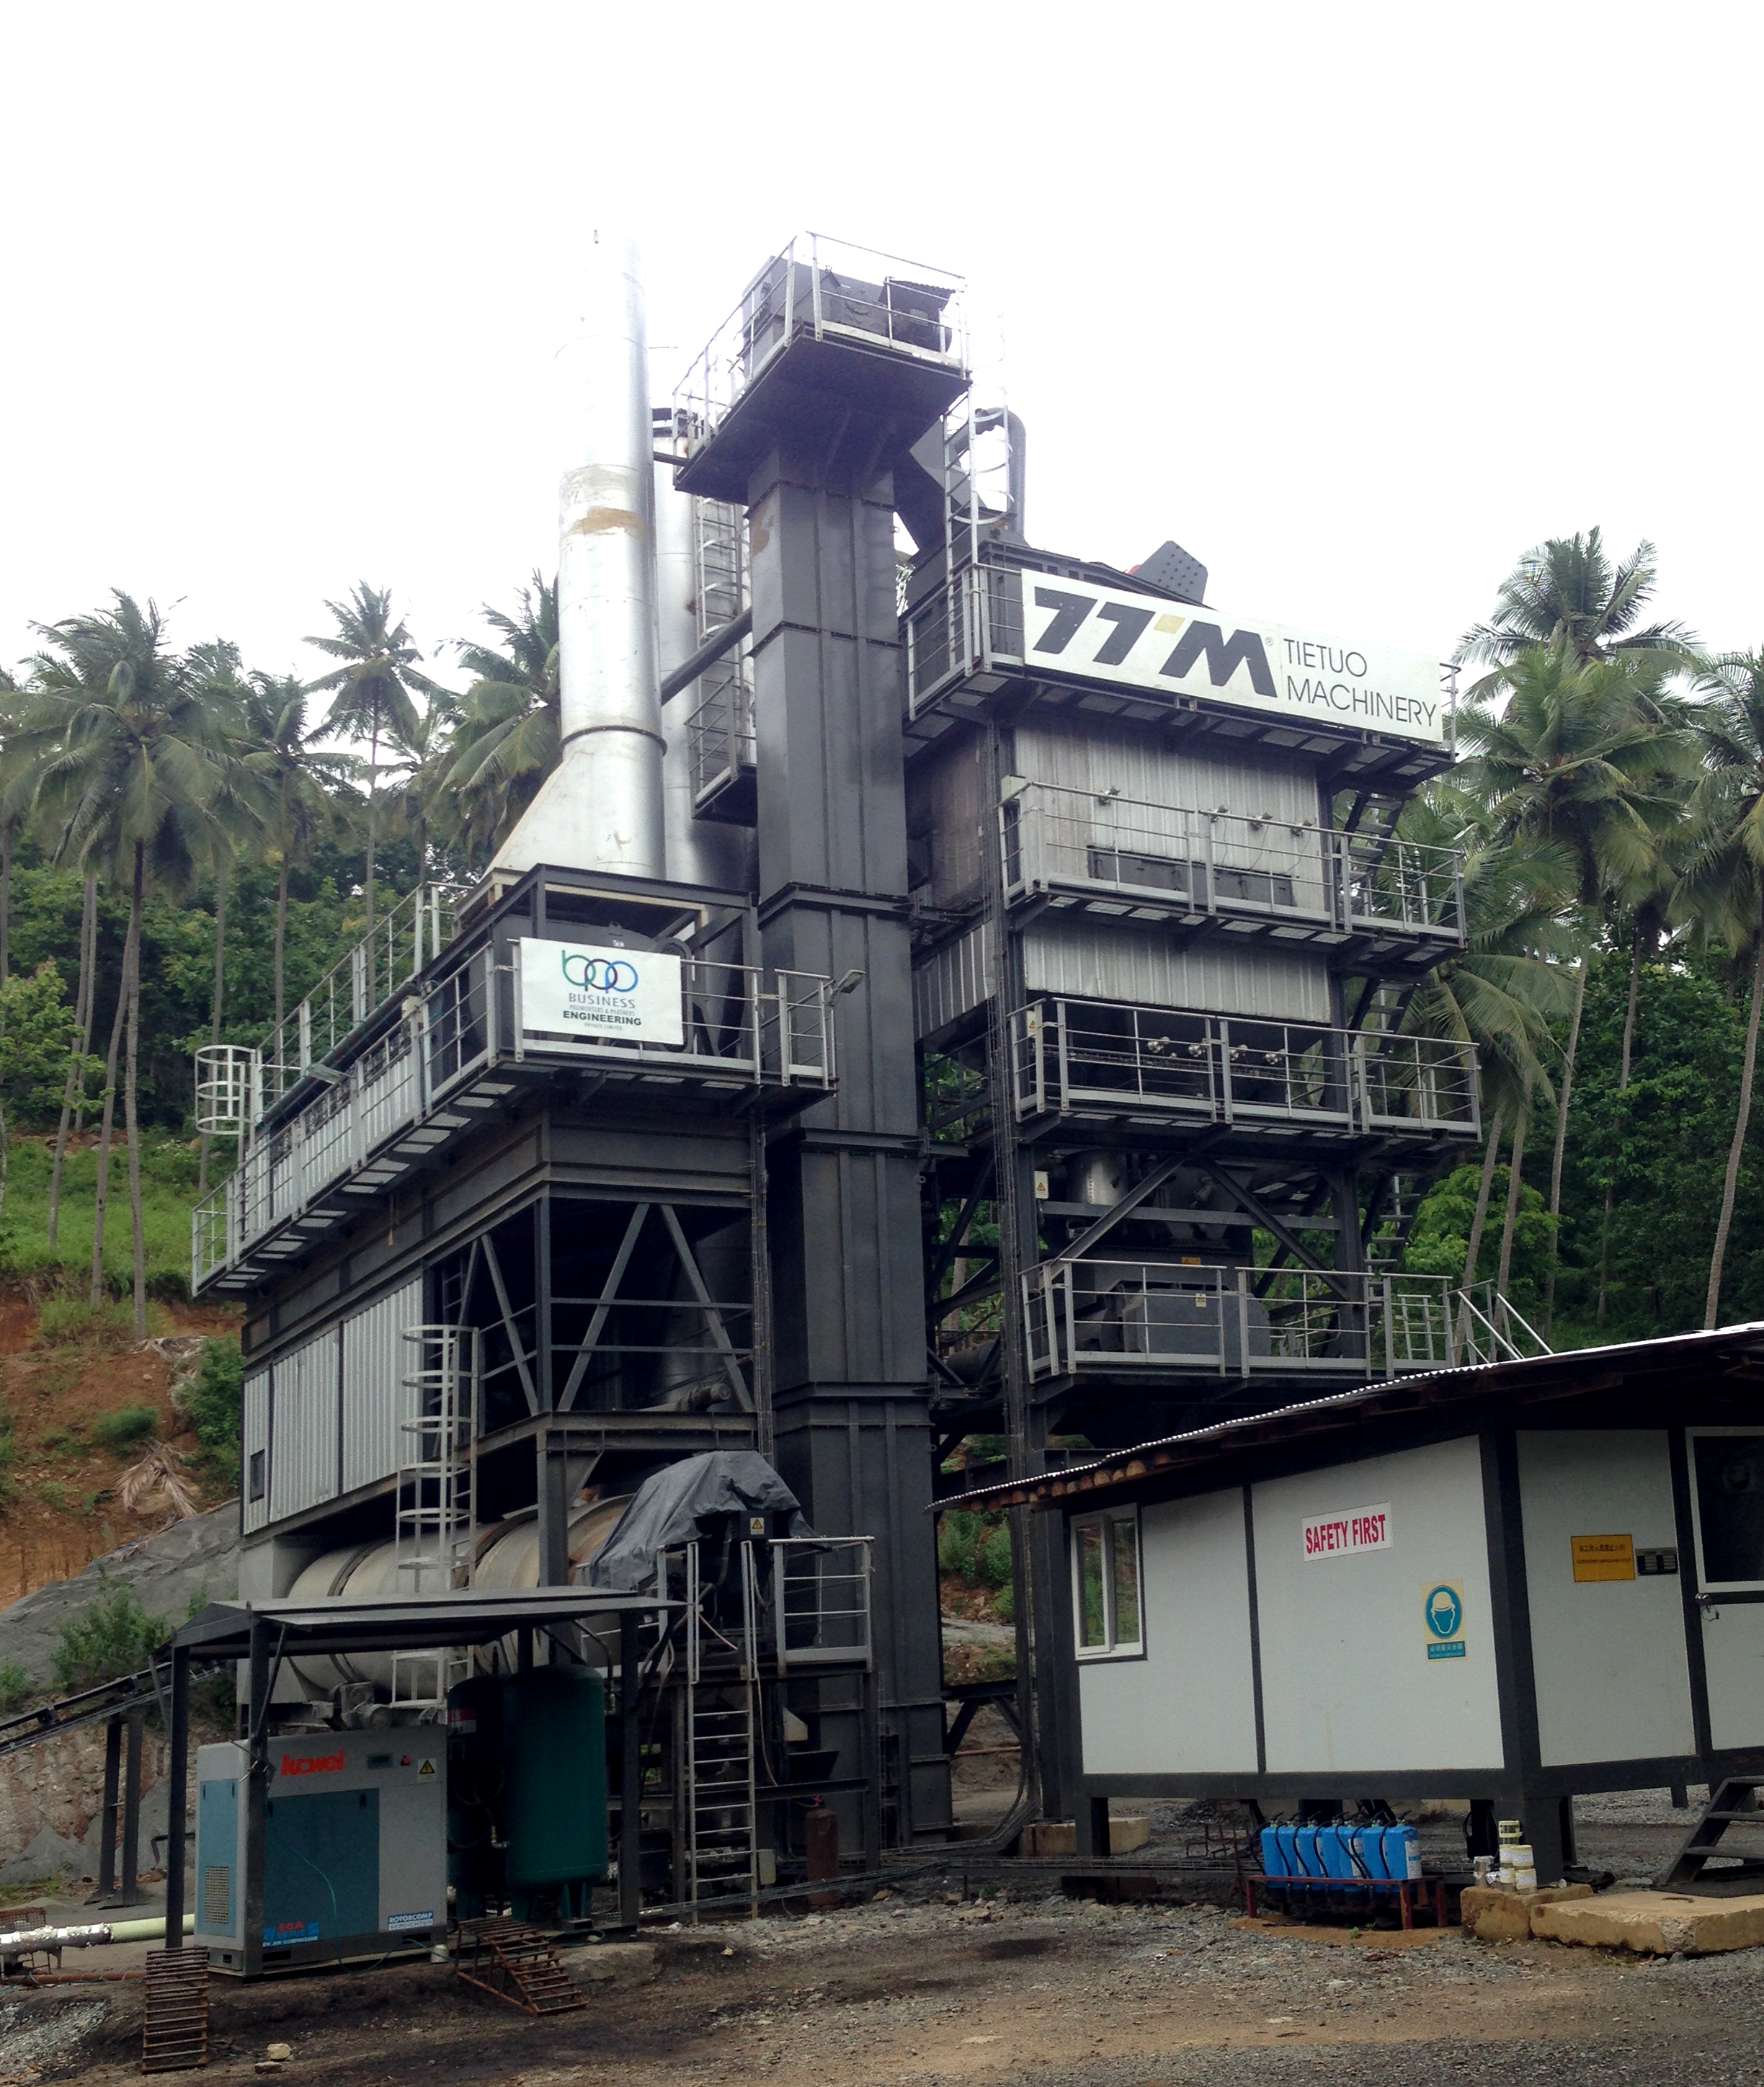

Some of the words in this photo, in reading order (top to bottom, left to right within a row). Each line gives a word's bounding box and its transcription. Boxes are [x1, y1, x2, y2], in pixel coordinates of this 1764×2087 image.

[1283, 638, 1368, 677] TIETUO
[1288, 675, 1438, 727] MACHINERY
[563, 1010, 642, 1025] ENGINEERING
[569, 993, 636, 1009] BUSINESS
[1306, 1521, 1348, 1554] SAFETY
[1352, 1514, 1386, 1546] FIRST
